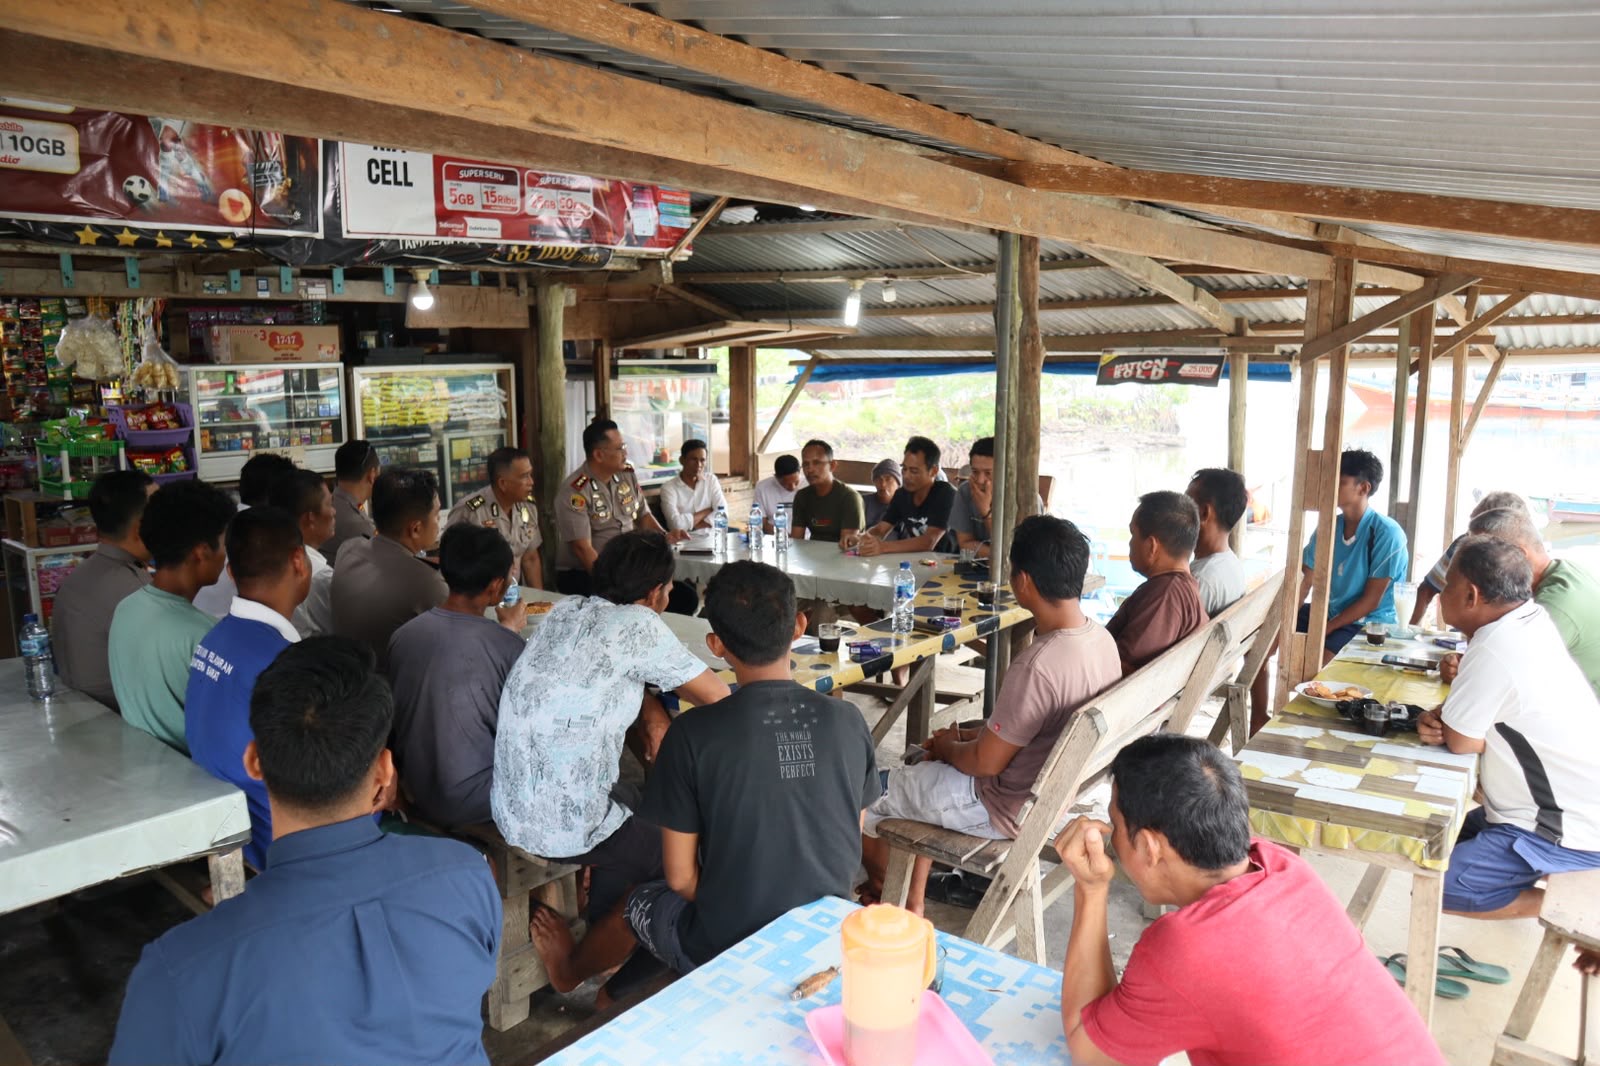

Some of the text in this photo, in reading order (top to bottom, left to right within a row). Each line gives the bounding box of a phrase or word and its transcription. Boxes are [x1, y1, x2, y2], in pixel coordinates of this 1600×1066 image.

[0, 122, 23, 132] obile
[9, 135, 66, 156] 10GB
[0, 154, 20, 164] dio
[367, 158, 413, 187] CELL
[449, 188, 474, 206] 5GB
[775, 729, 812, 743] THE WORLD
[777, 743, 815, 762] EXISTS
[780, 762, 817, 779] PERFECT
